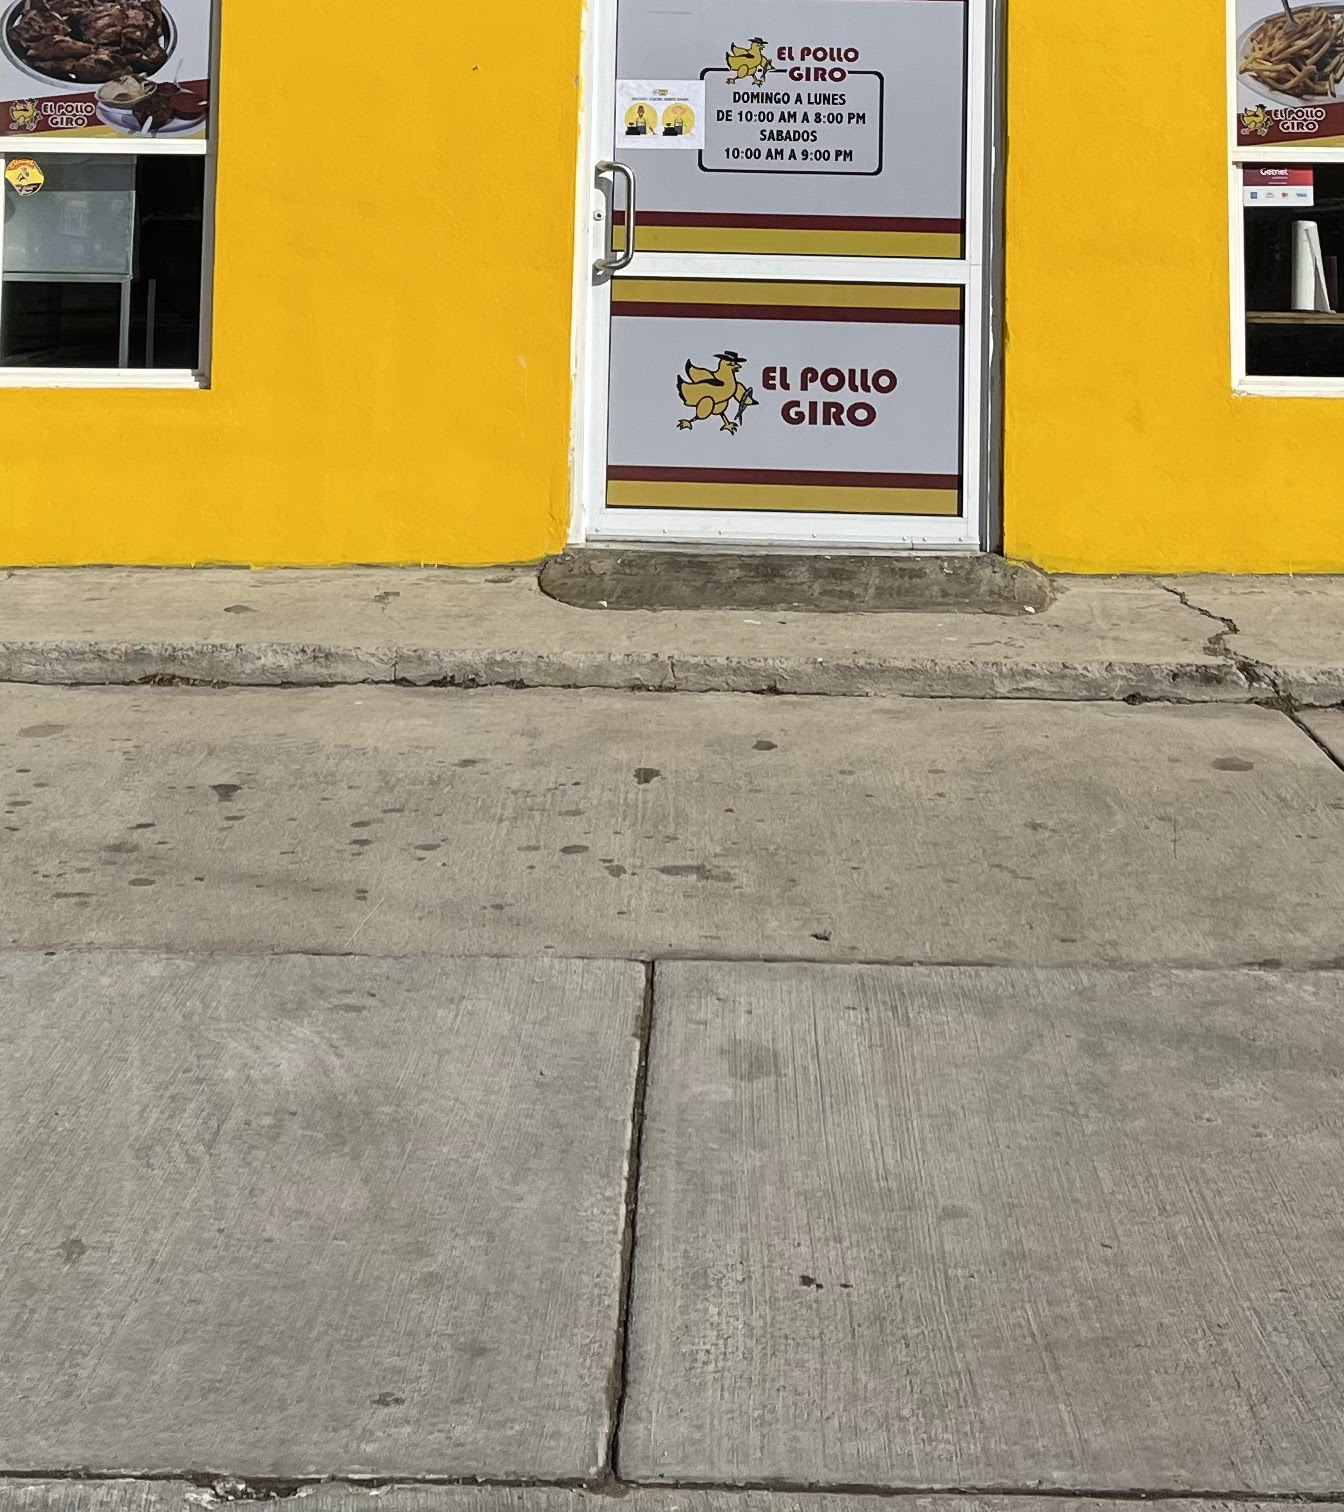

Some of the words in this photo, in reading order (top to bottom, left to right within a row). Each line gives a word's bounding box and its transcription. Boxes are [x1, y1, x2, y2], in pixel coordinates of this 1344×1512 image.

[777, 47, 794, 61] EL
[800, 47, 859, 62] POLLO
[788, 67, 847, 83] GIRO
[733, 92, 790, 104] DOMINGO
[795, 93, 802, 104] A
[808, 93, 846, 105] LUNES
[41, 103, 54, 117] EL
[55, 101, 95, 117] POLLO
[1272, 110, 1286, 121] EL
[1287, 108, 1325, 121] POLLO
[47, 113, 87, 128] GIRO
[717, 110, 732, 121] DE
[738, 111, 774, 122] 10:00
[778, 111, 796, 123] AM
[801, 112, 809, 123] A
[814, 112, 843, 124] 8:00
[848, 113, 865, 124] PM
[1279, 120, 1319, 133] GIRO
[760, 129, 817, 142] SABADOS
[725, 148, 761, 159] 10:00
[765, 148, 784, 160] AM
[788, 149, 797, 160] A
[801, 149, 830, 161] 9:00
[835, 150, 852, 161] PM
[762, 366, 790, 390] EL
[800, 367, 897, 393] POLLO
[781, 400, 876, 427] GIRO
